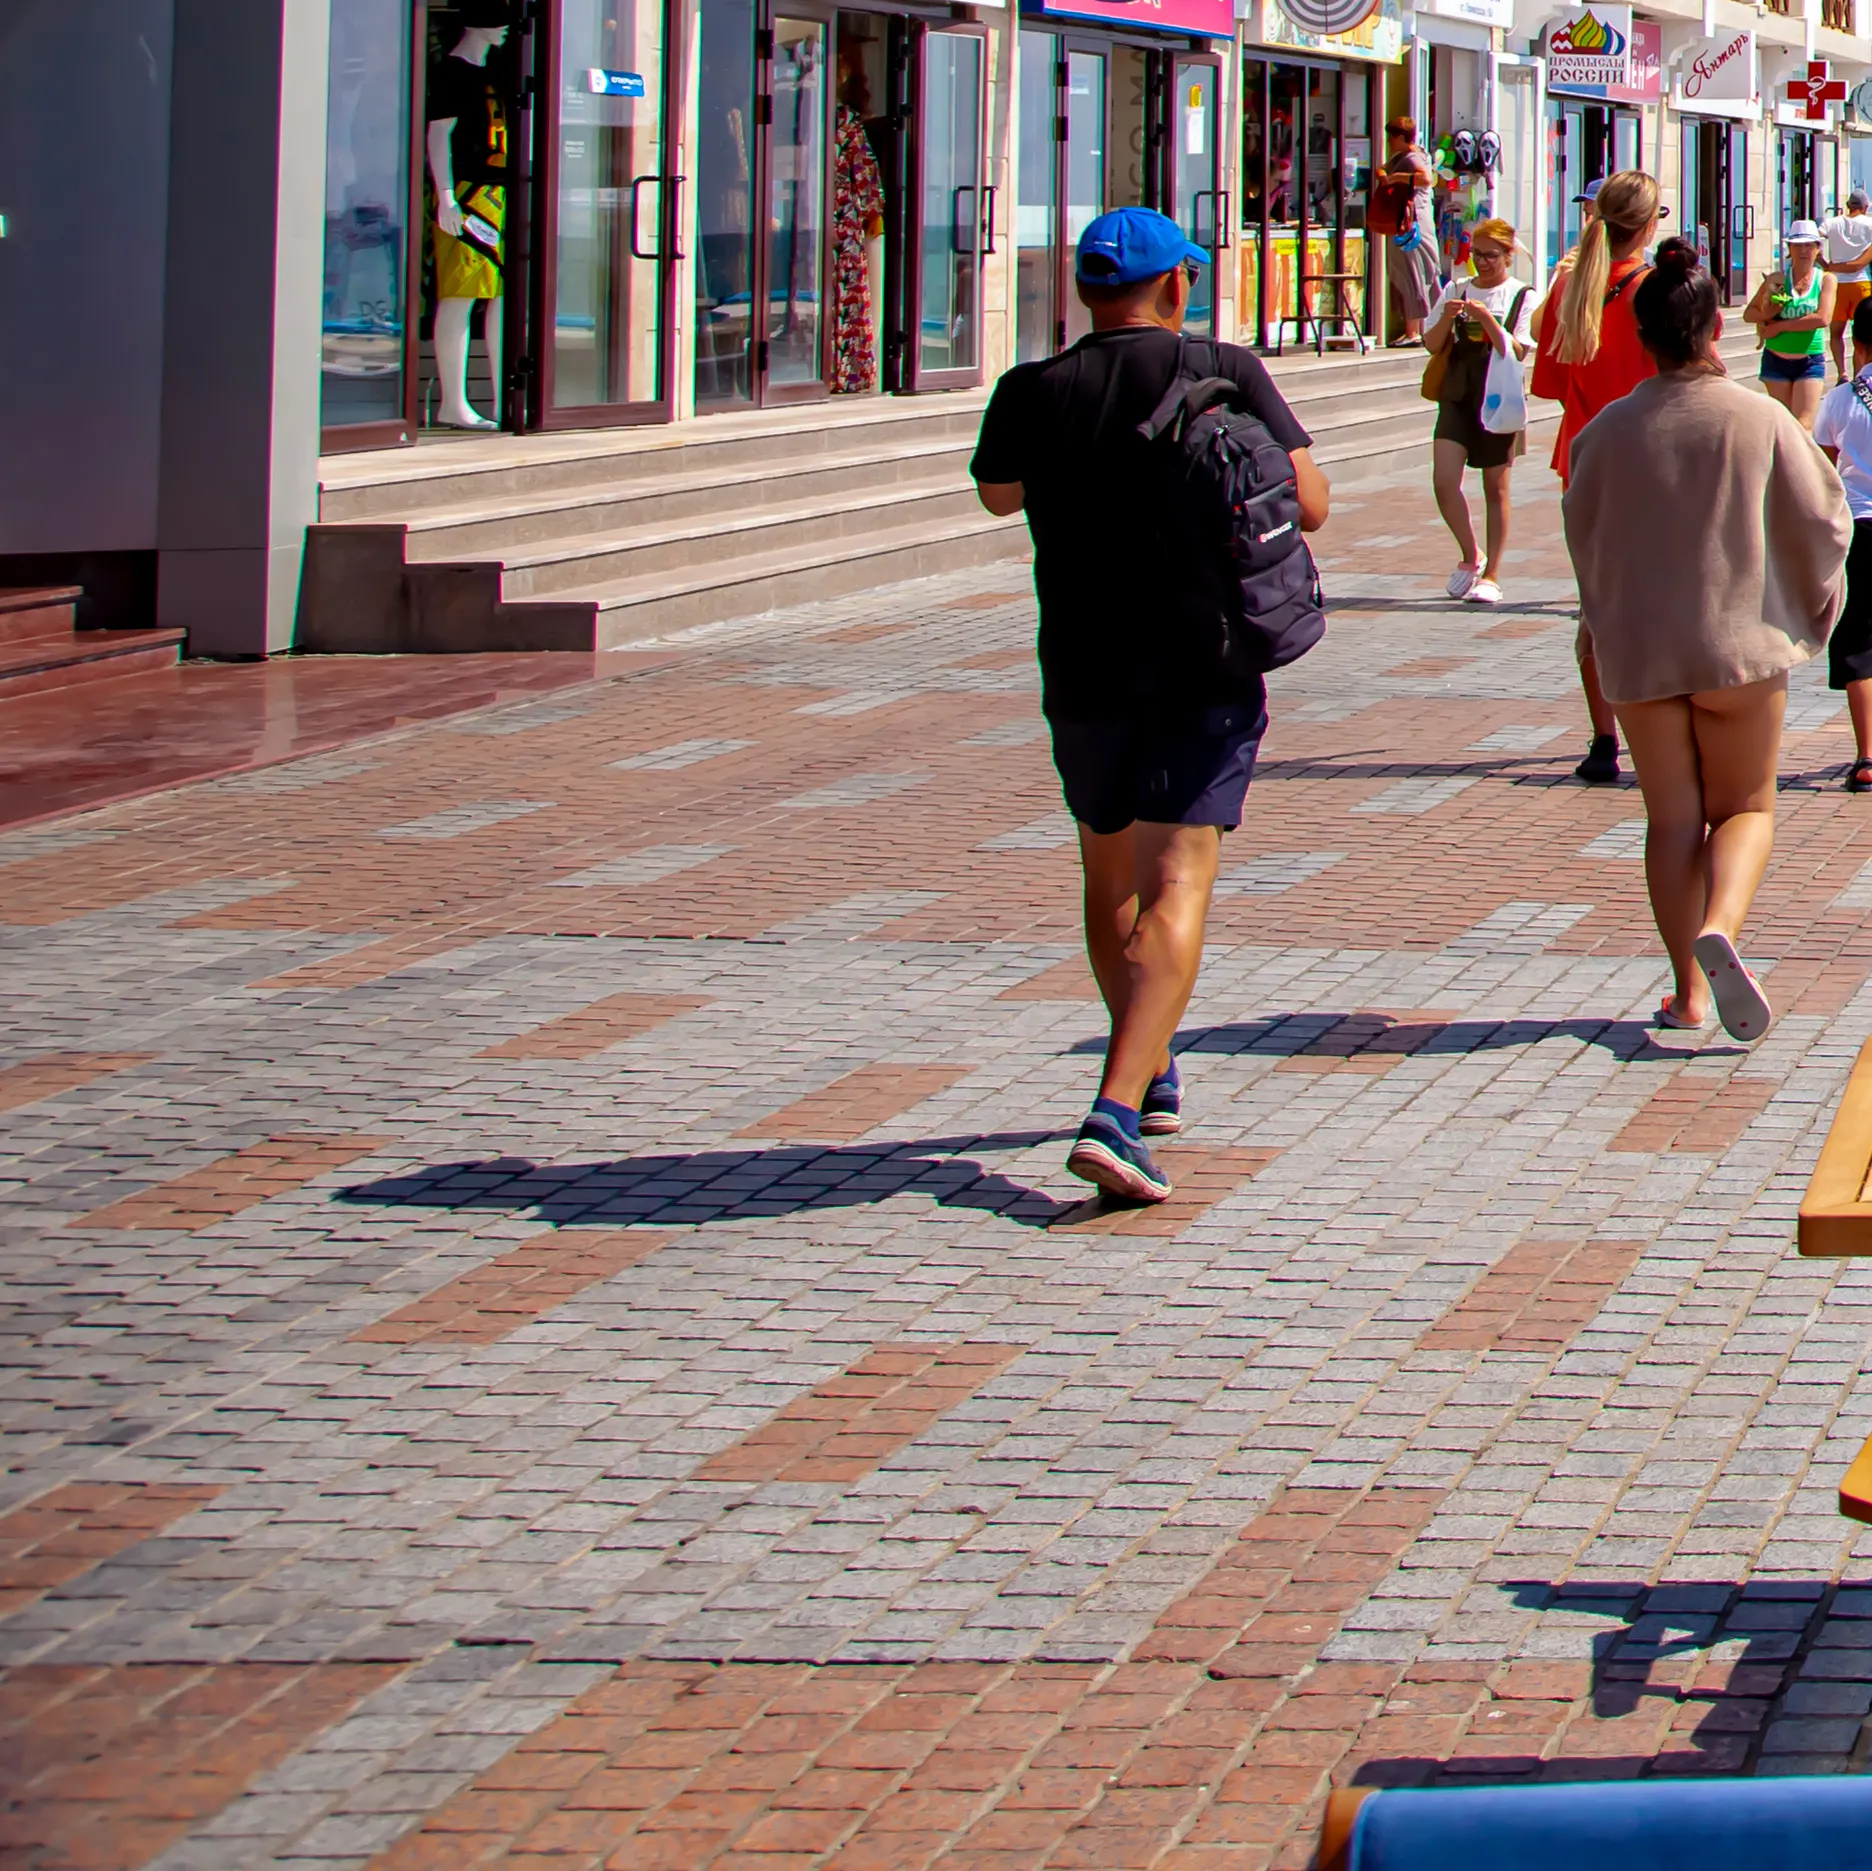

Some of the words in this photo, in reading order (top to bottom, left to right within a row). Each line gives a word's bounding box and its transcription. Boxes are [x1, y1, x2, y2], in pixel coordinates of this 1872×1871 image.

[1549, 56, 1626, 68] ПРОМЫСЛЫ
[1685, 33, 1749, 98] Янтарь
[1549, 68, 1625, 84] РОССИИ
